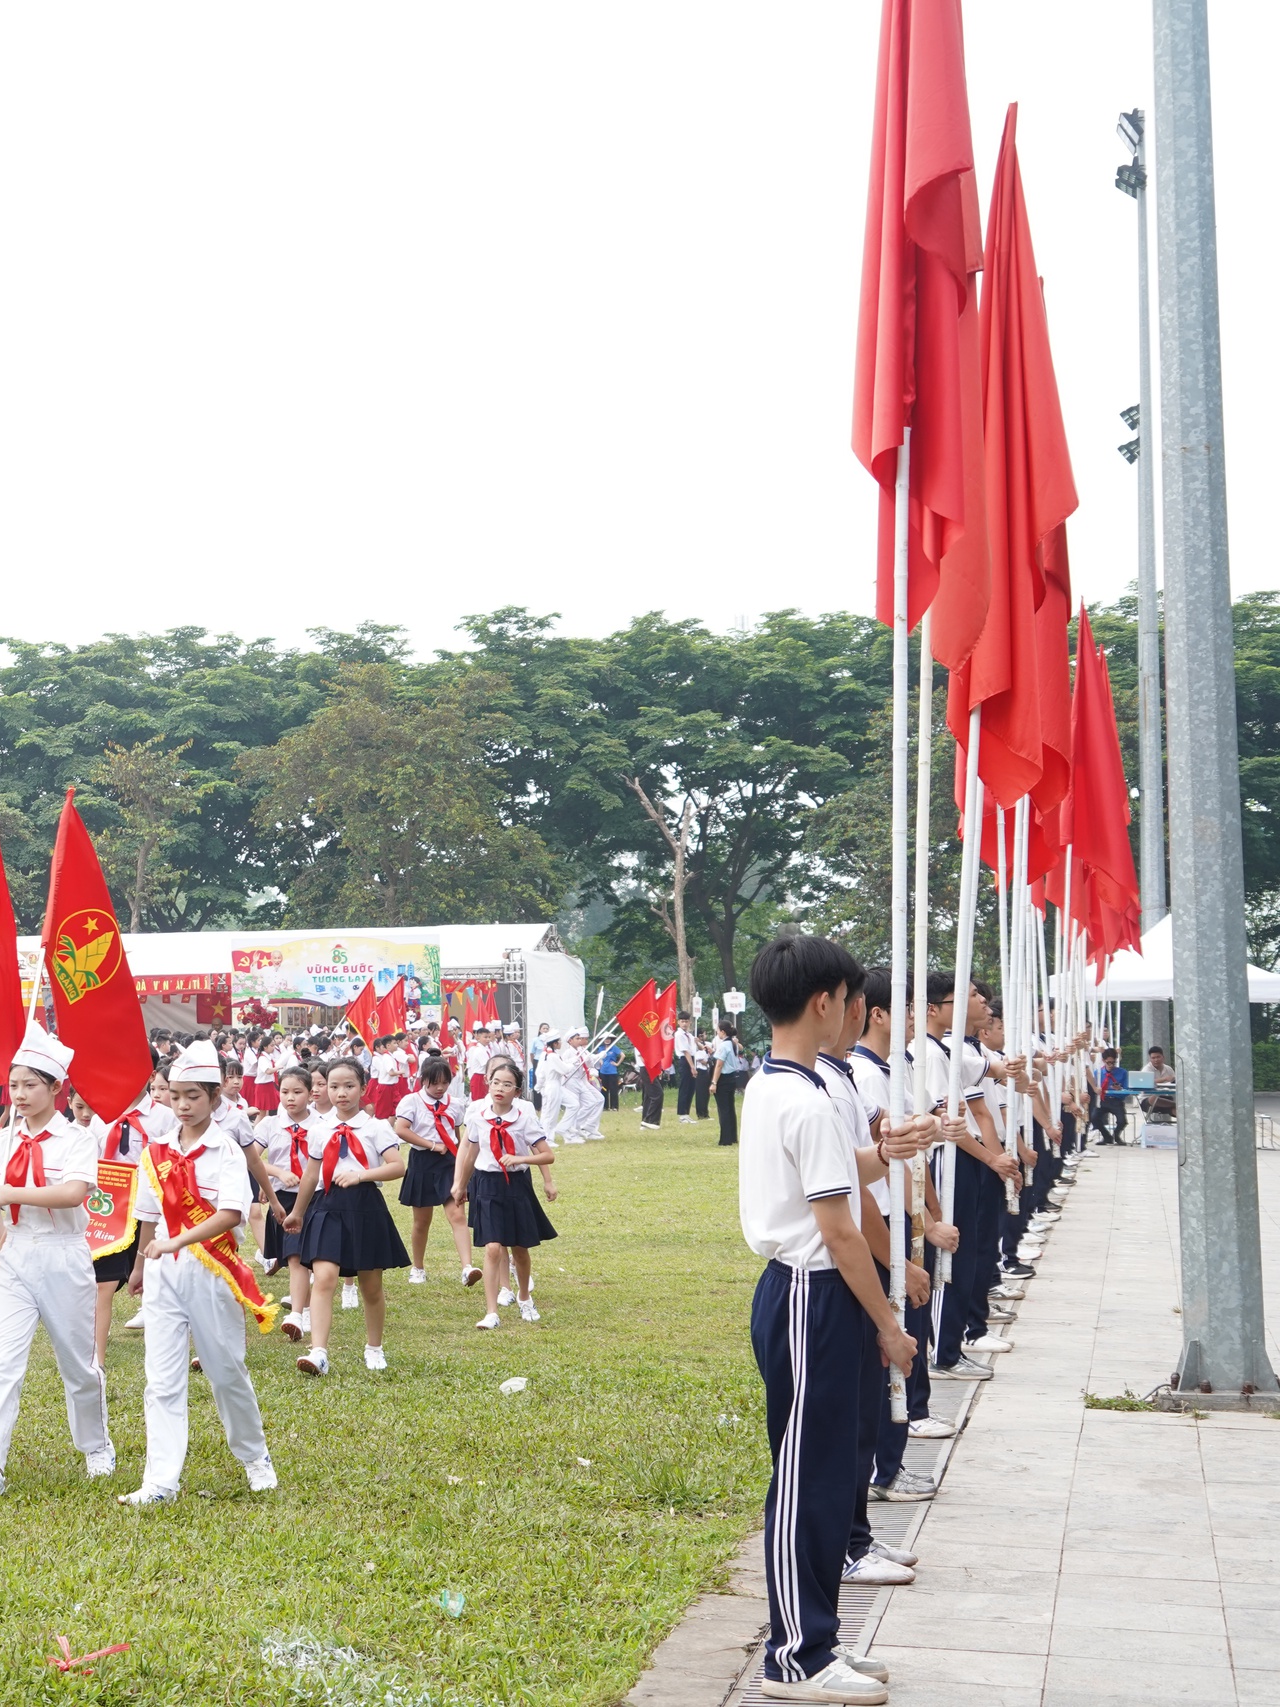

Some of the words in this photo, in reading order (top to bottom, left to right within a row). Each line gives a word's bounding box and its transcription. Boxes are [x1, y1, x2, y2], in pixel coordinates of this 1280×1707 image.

[332, 949, 348, 964] 85
[307, 964, 338, 974] VỮNG
[343, 963, 375, 974] BƯỚC
[59, 973, 77, 999] SÀNG
[88, 1189, 113, 1215] 85
[187, 1205, 212, 1226] HỒ
[93, 1229, 116, 1242] Niệm
